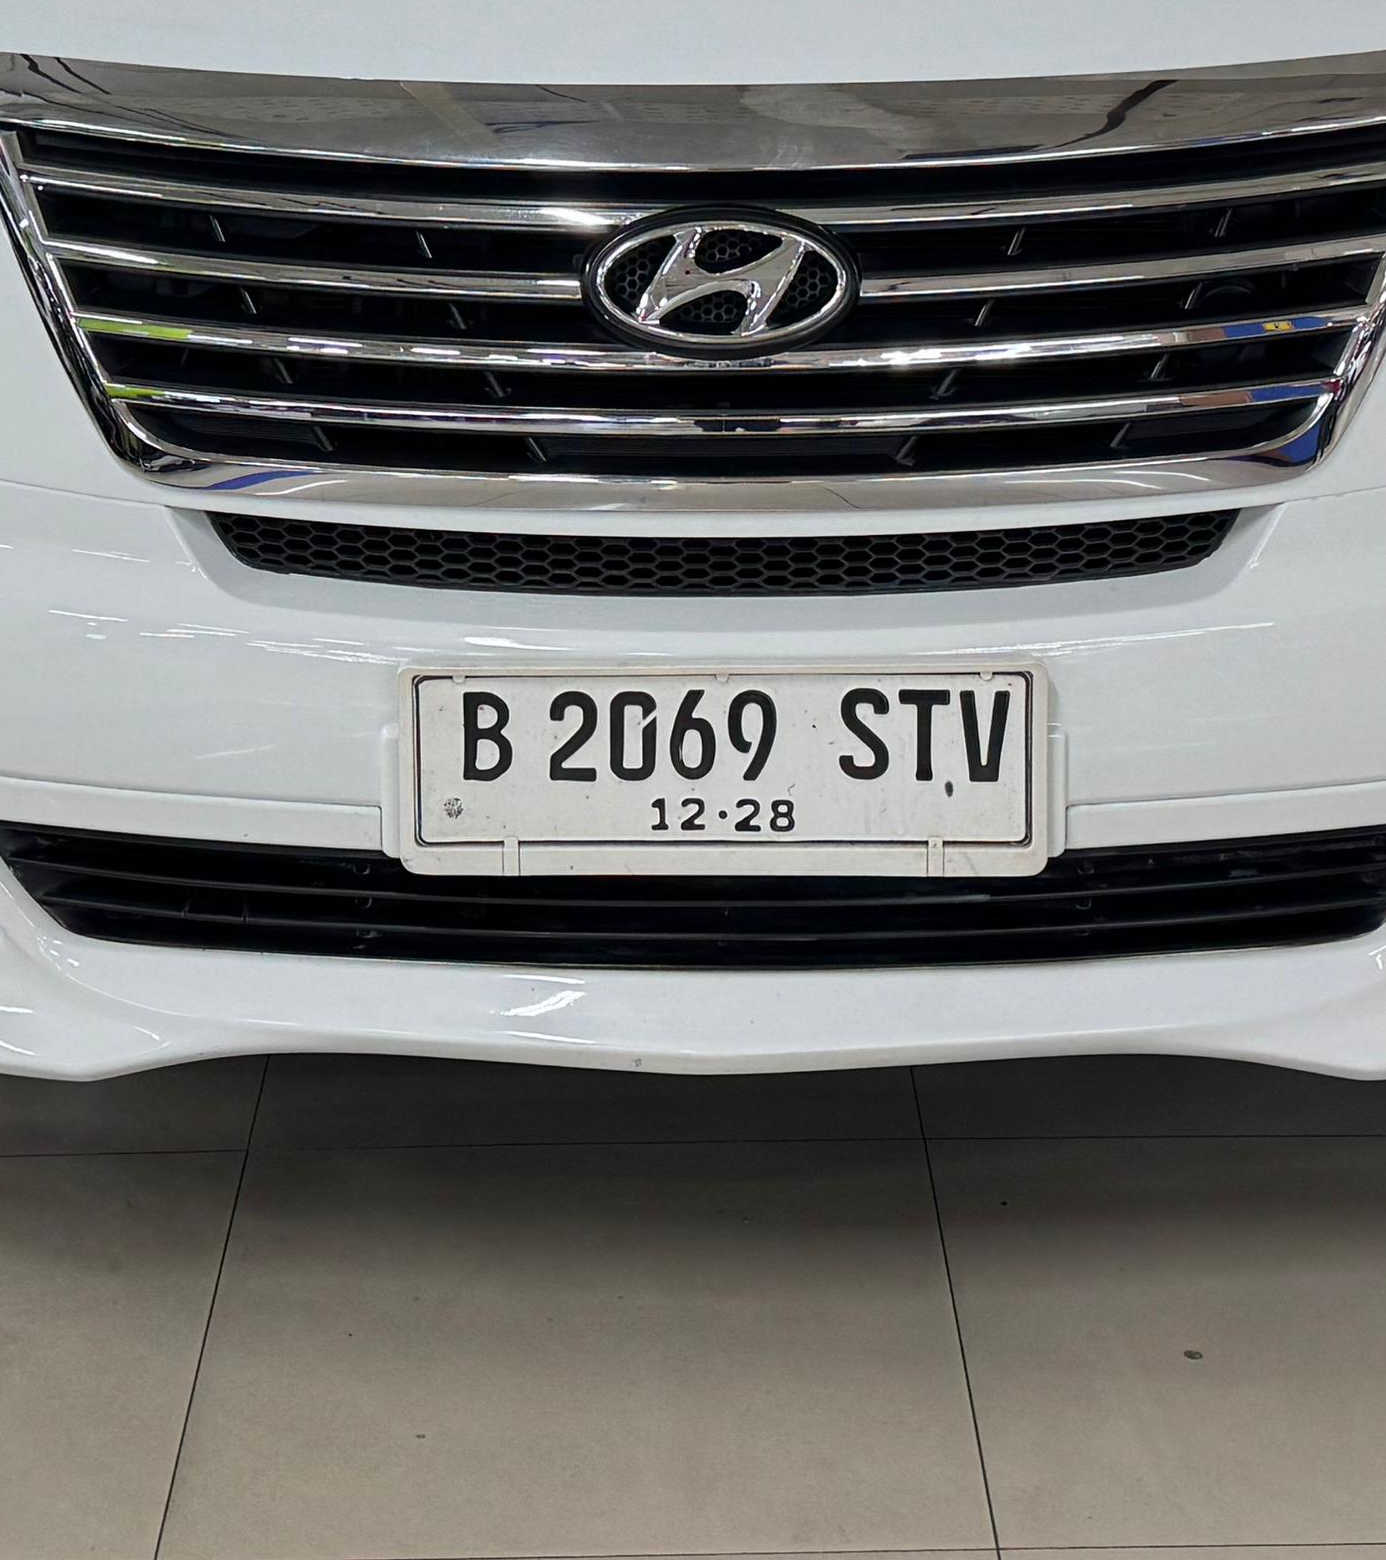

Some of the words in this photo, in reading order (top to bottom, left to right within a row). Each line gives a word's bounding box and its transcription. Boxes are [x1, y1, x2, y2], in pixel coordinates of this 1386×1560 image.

[462, 690, 513, 782] B
[549, 689, 777, 782] 2069
[838, 687, 1011, 783] STV
